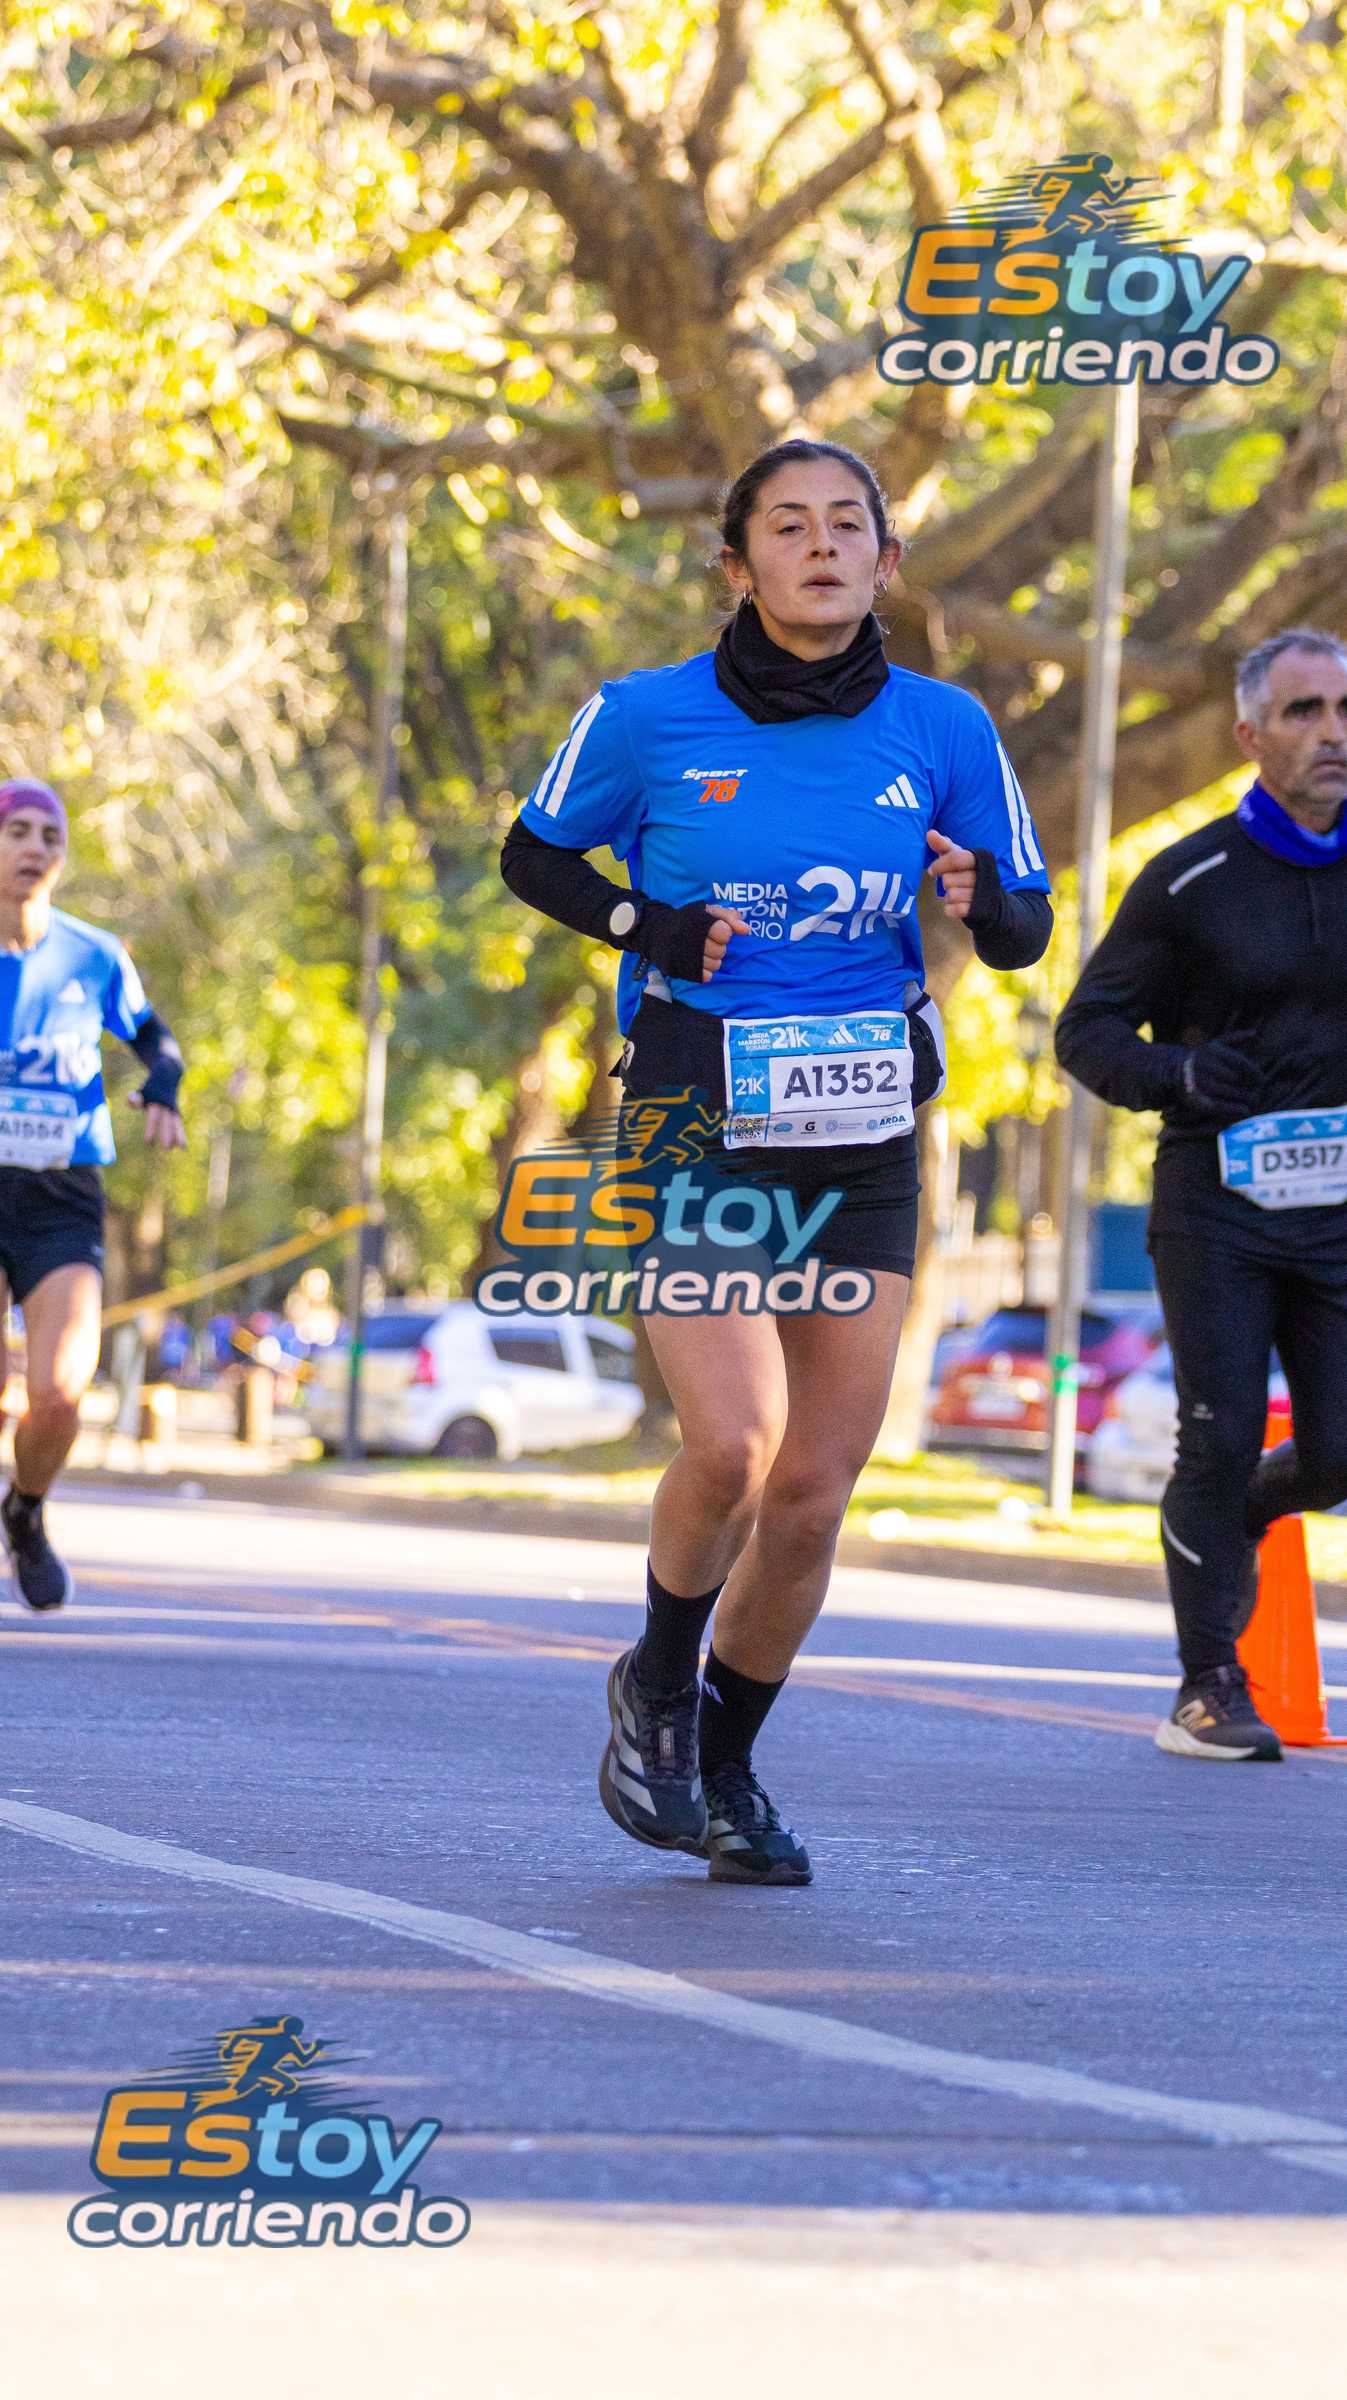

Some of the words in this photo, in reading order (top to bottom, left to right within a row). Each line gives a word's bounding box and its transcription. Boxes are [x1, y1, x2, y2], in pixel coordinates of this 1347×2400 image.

[699, 779, 739, 803] 78
[712, 882, 788, 902] MEDIA
[871, 1029, 892, 1042] 78
[735, 1077, 765, 1096] 21K
[783, 1060, 898, 1099] A1352
[1263, 1144, 1344, 1173] D3517
